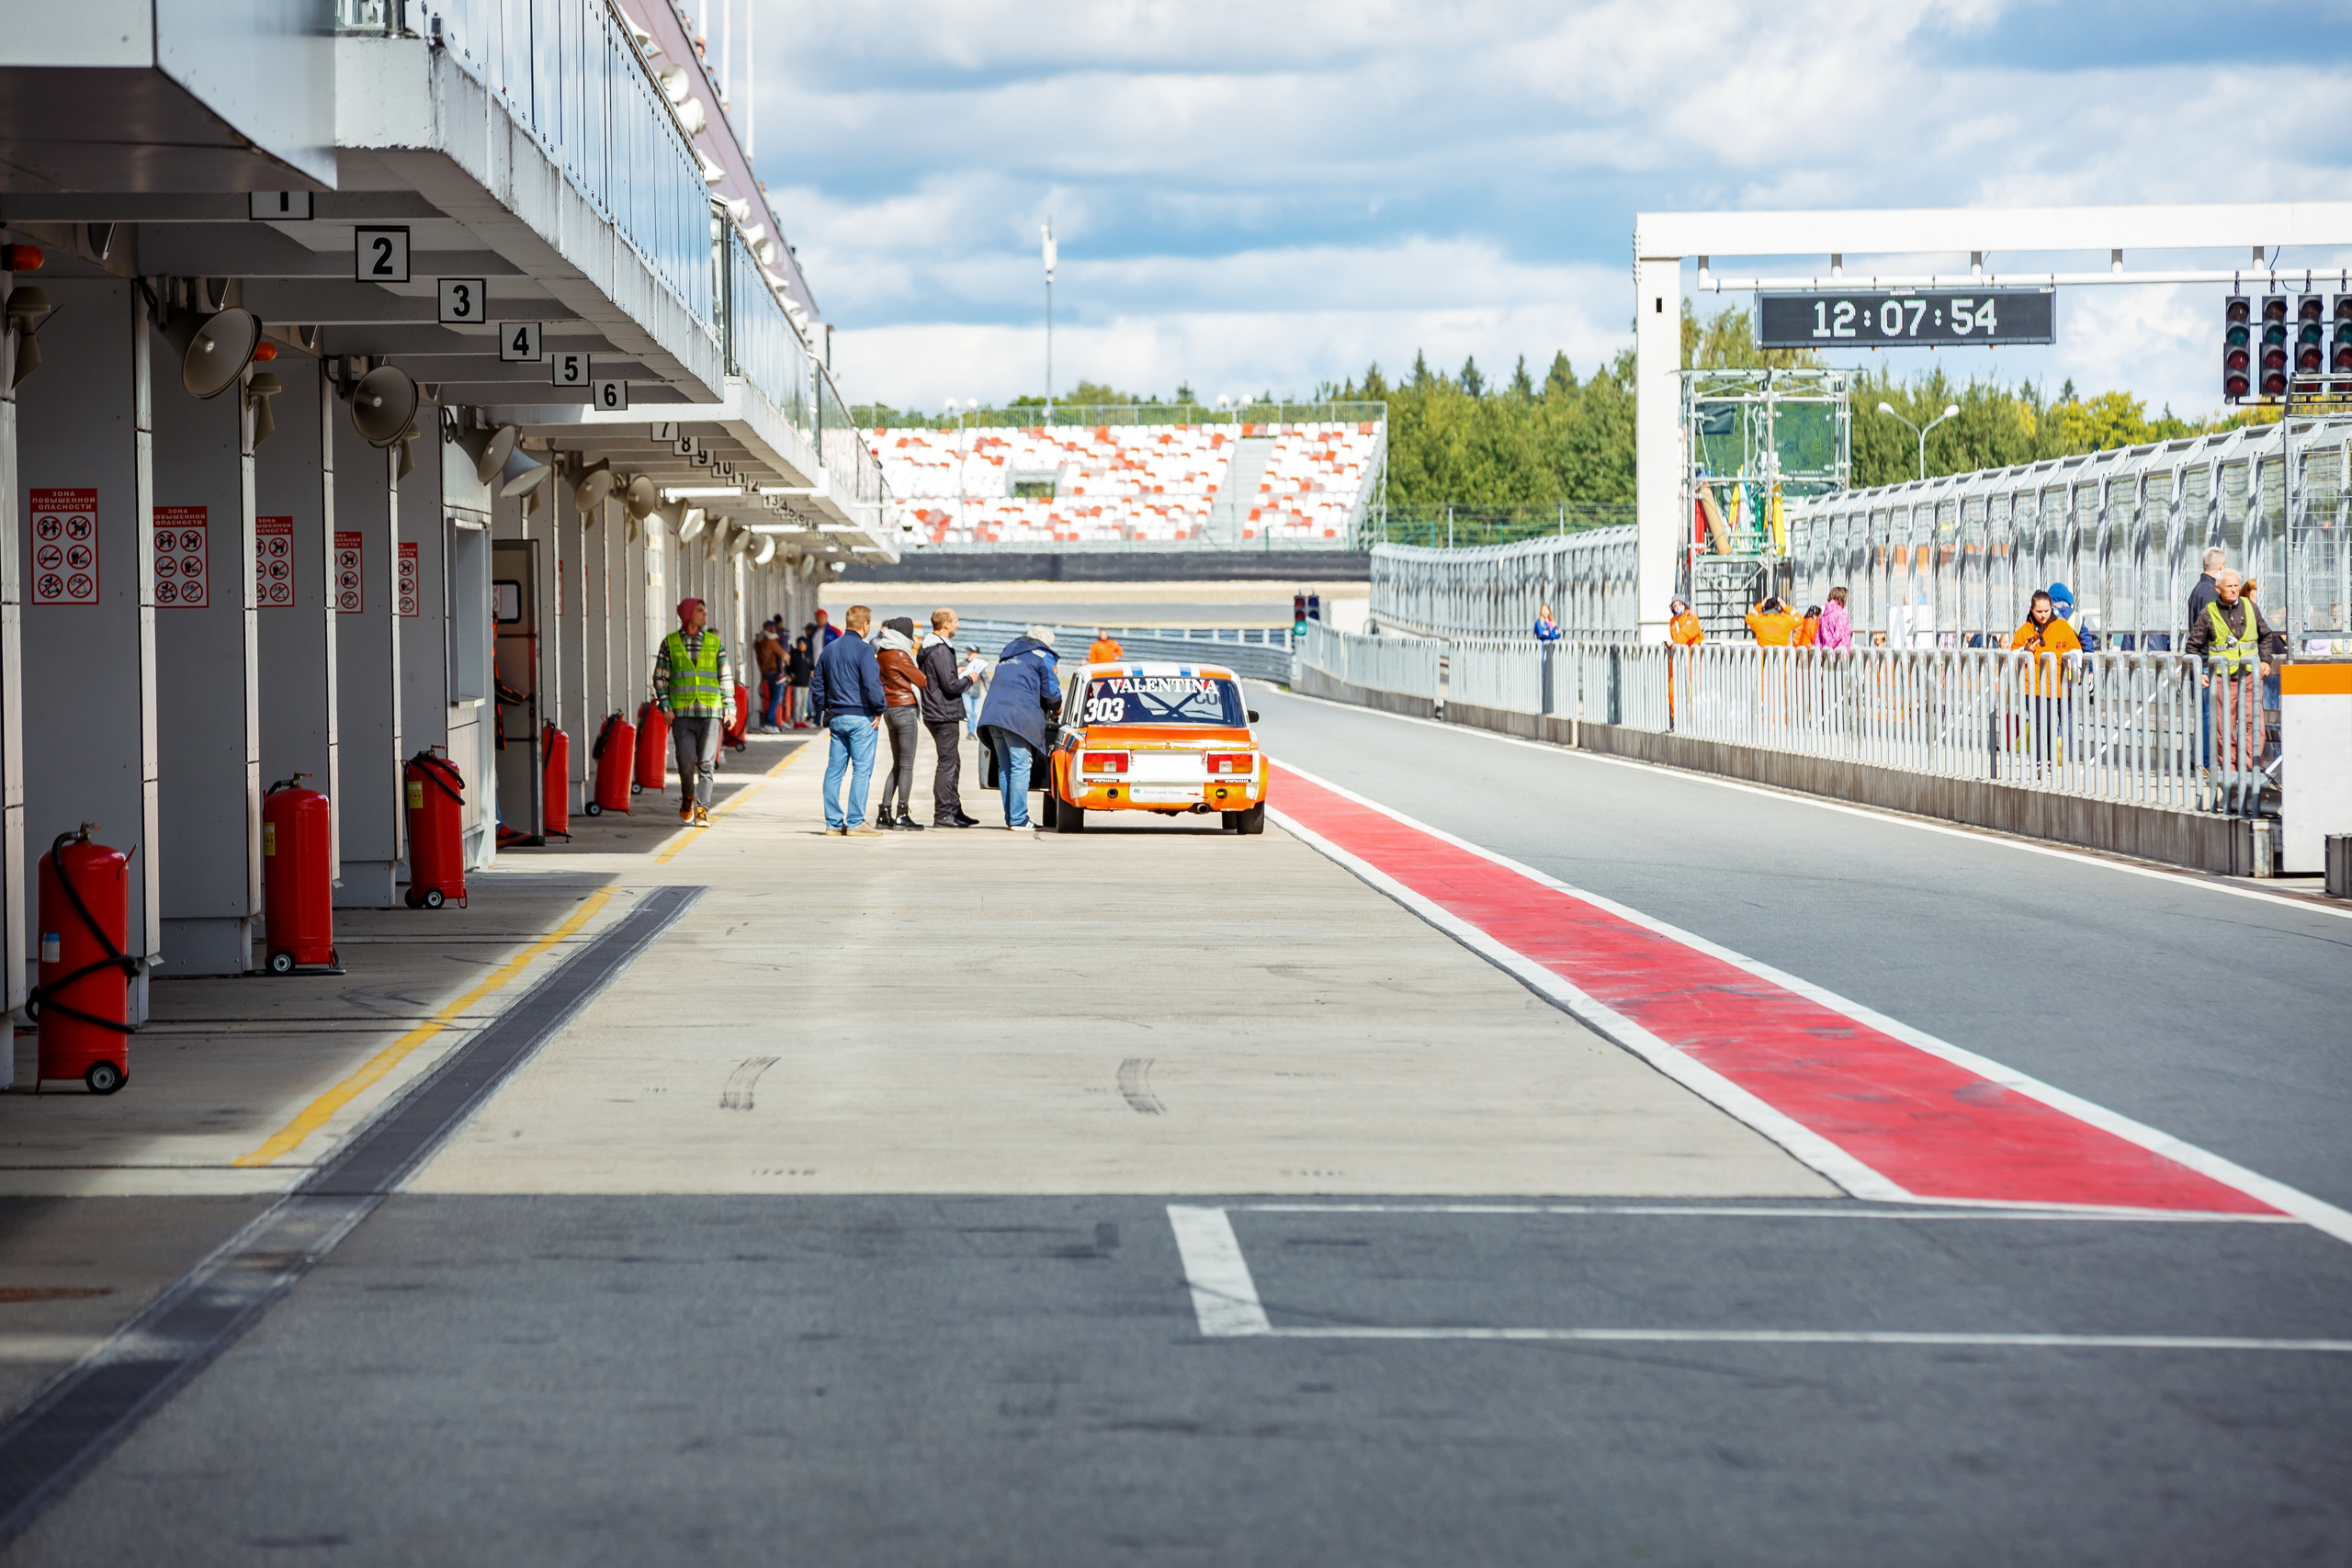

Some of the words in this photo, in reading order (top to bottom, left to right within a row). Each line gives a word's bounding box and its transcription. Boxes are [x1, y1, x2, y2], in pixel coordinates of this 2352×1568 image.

[372, 237, 393, 275] 2
[452, 284, 470, 317] 3
[1813, 298, 1997, 338] 12:07:54
[512, 327, 529, 356] 4
[564, 355, 579, 381] 5
[604, 383, 617, 407] 6
[660, 422, 670, 438] 7
[681, 436, 691, 453] 8
[698, 449, 707, 465] 9
[714, 461, 731, 475] 10
[1108, 678, 1219, 694] VALENTINA
[1083, 697, 1125, 723] 303
